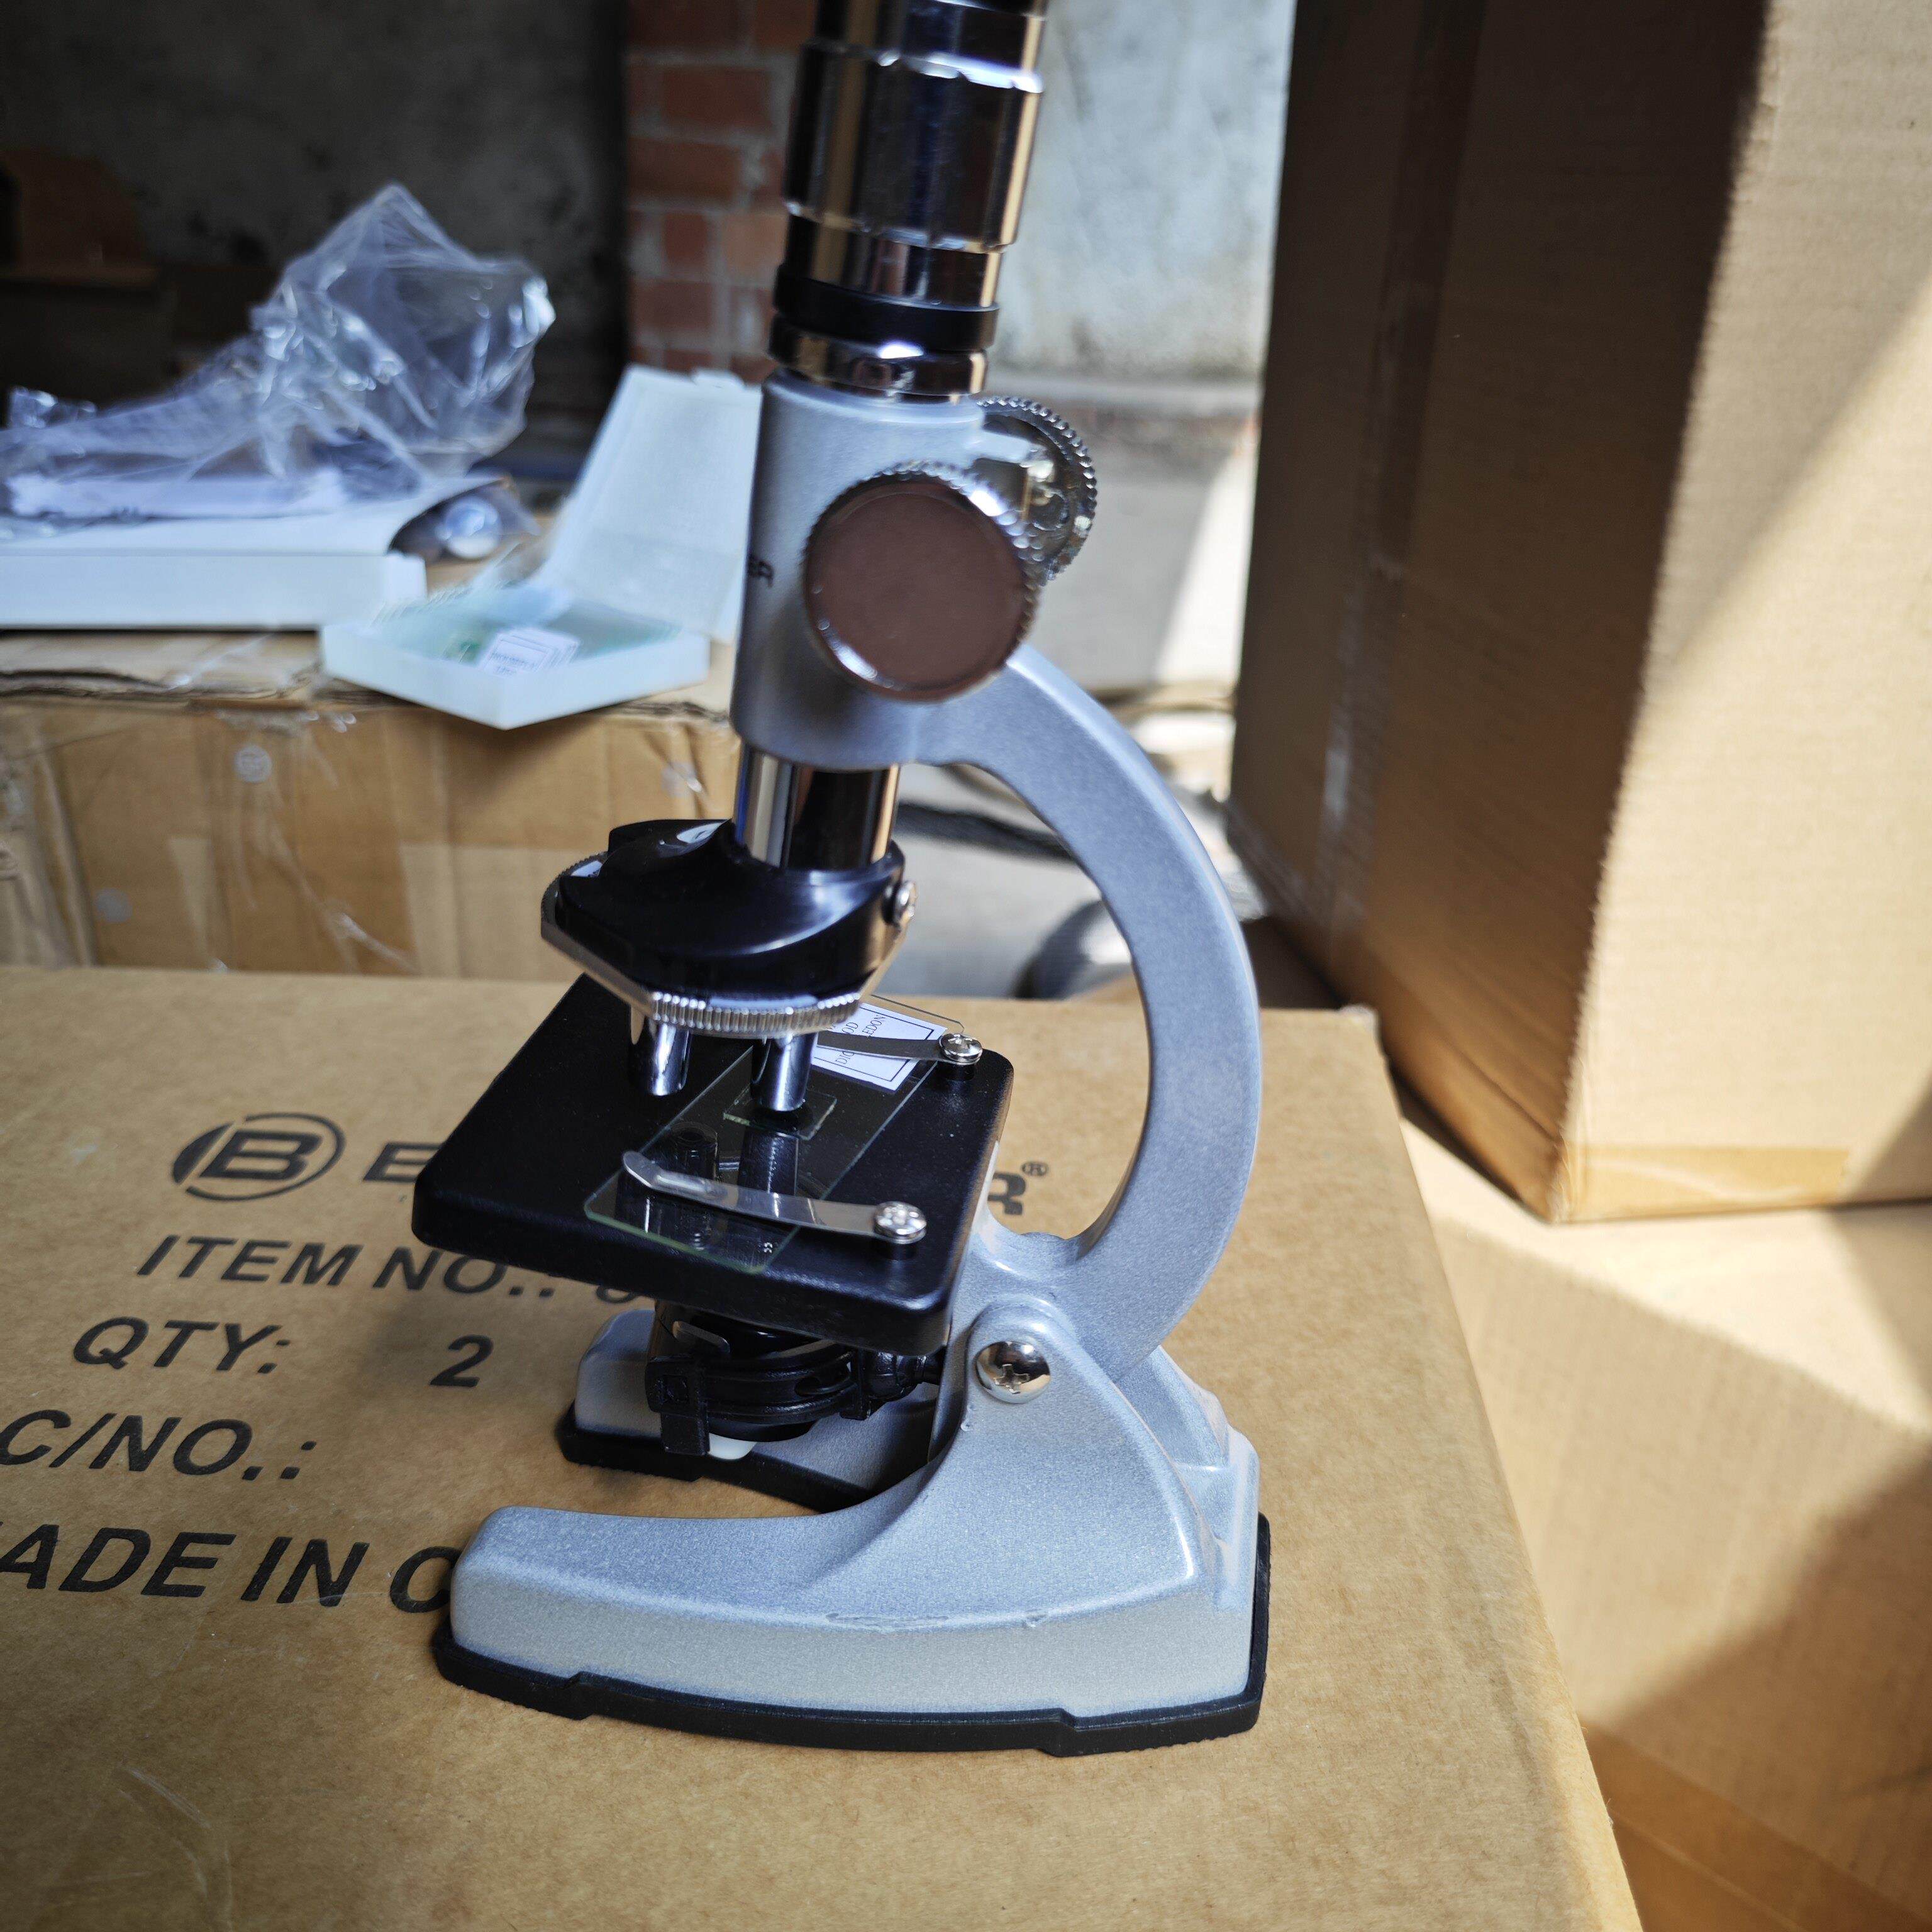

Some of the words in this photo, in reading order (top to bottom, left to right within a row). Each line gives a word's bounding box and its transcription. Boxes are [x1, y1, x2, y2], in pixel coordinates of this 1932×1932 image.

[136, 1235, 363, 1287] ITEM
[72, 1316, 291, 1375] QTY:
[428, 1335, 494, 1389] 2
[0, 1409, 317, 1481] C/NO.:
[0, 1522, 238, 1598] ADE
[240, 1536, 370, 1607] IN
